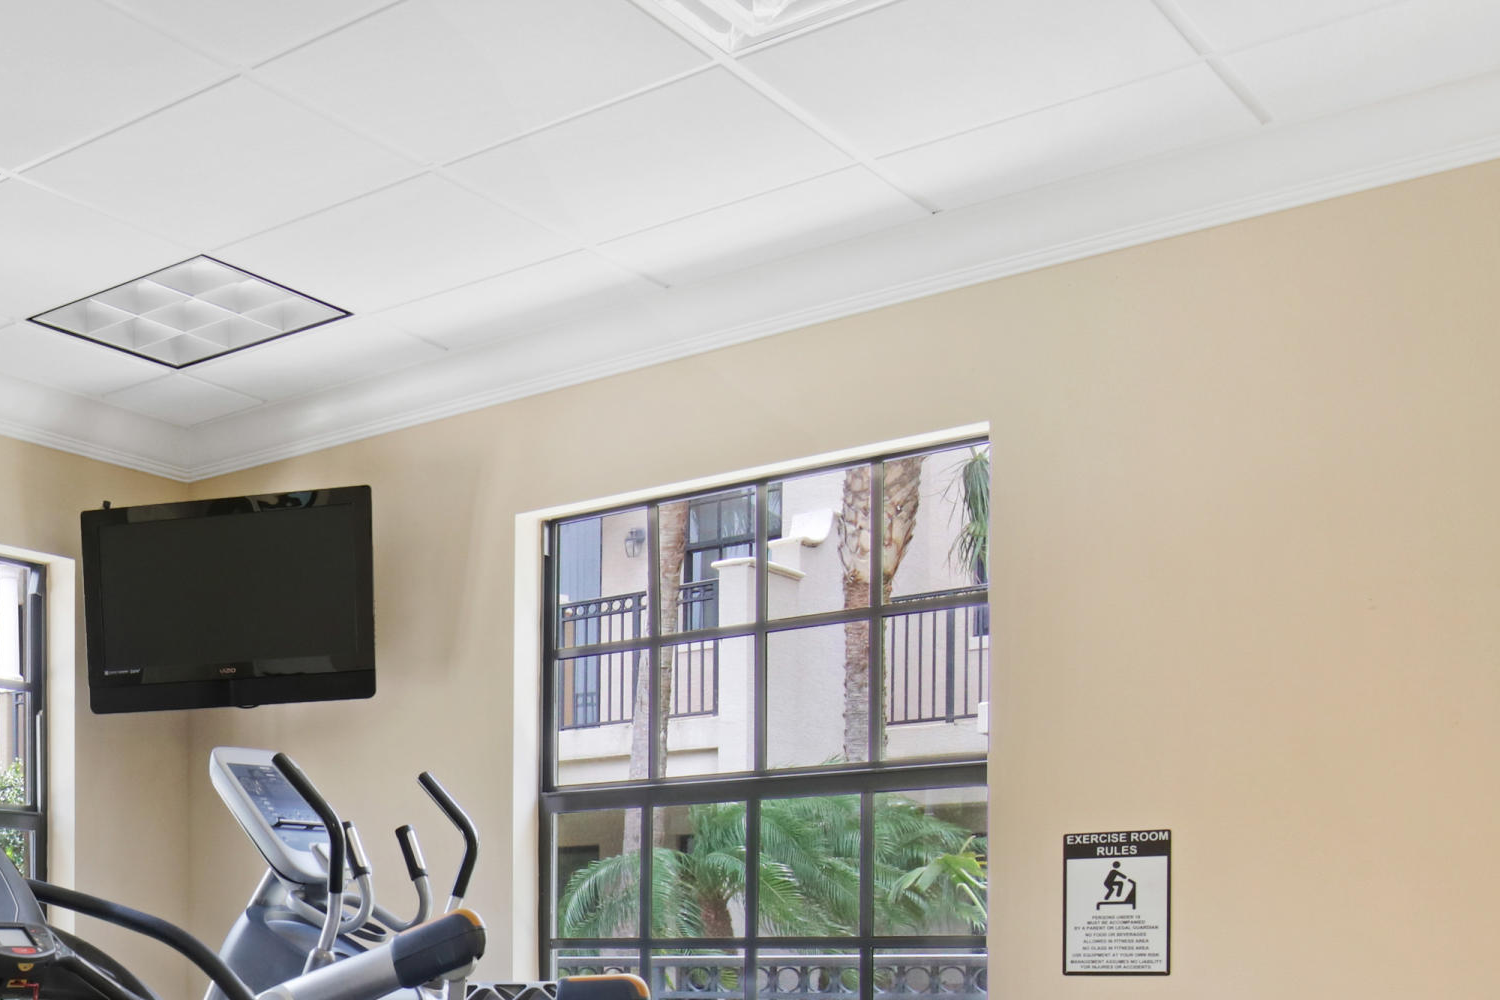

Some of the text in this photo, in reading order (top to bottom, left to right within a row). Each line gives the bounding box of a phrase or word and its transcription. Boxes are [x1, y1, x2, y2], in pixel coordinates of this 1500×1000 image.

[1067, 831, 1169, 844] EXERCISE ROOM
[1096, 845, 1138, 856] RULES
